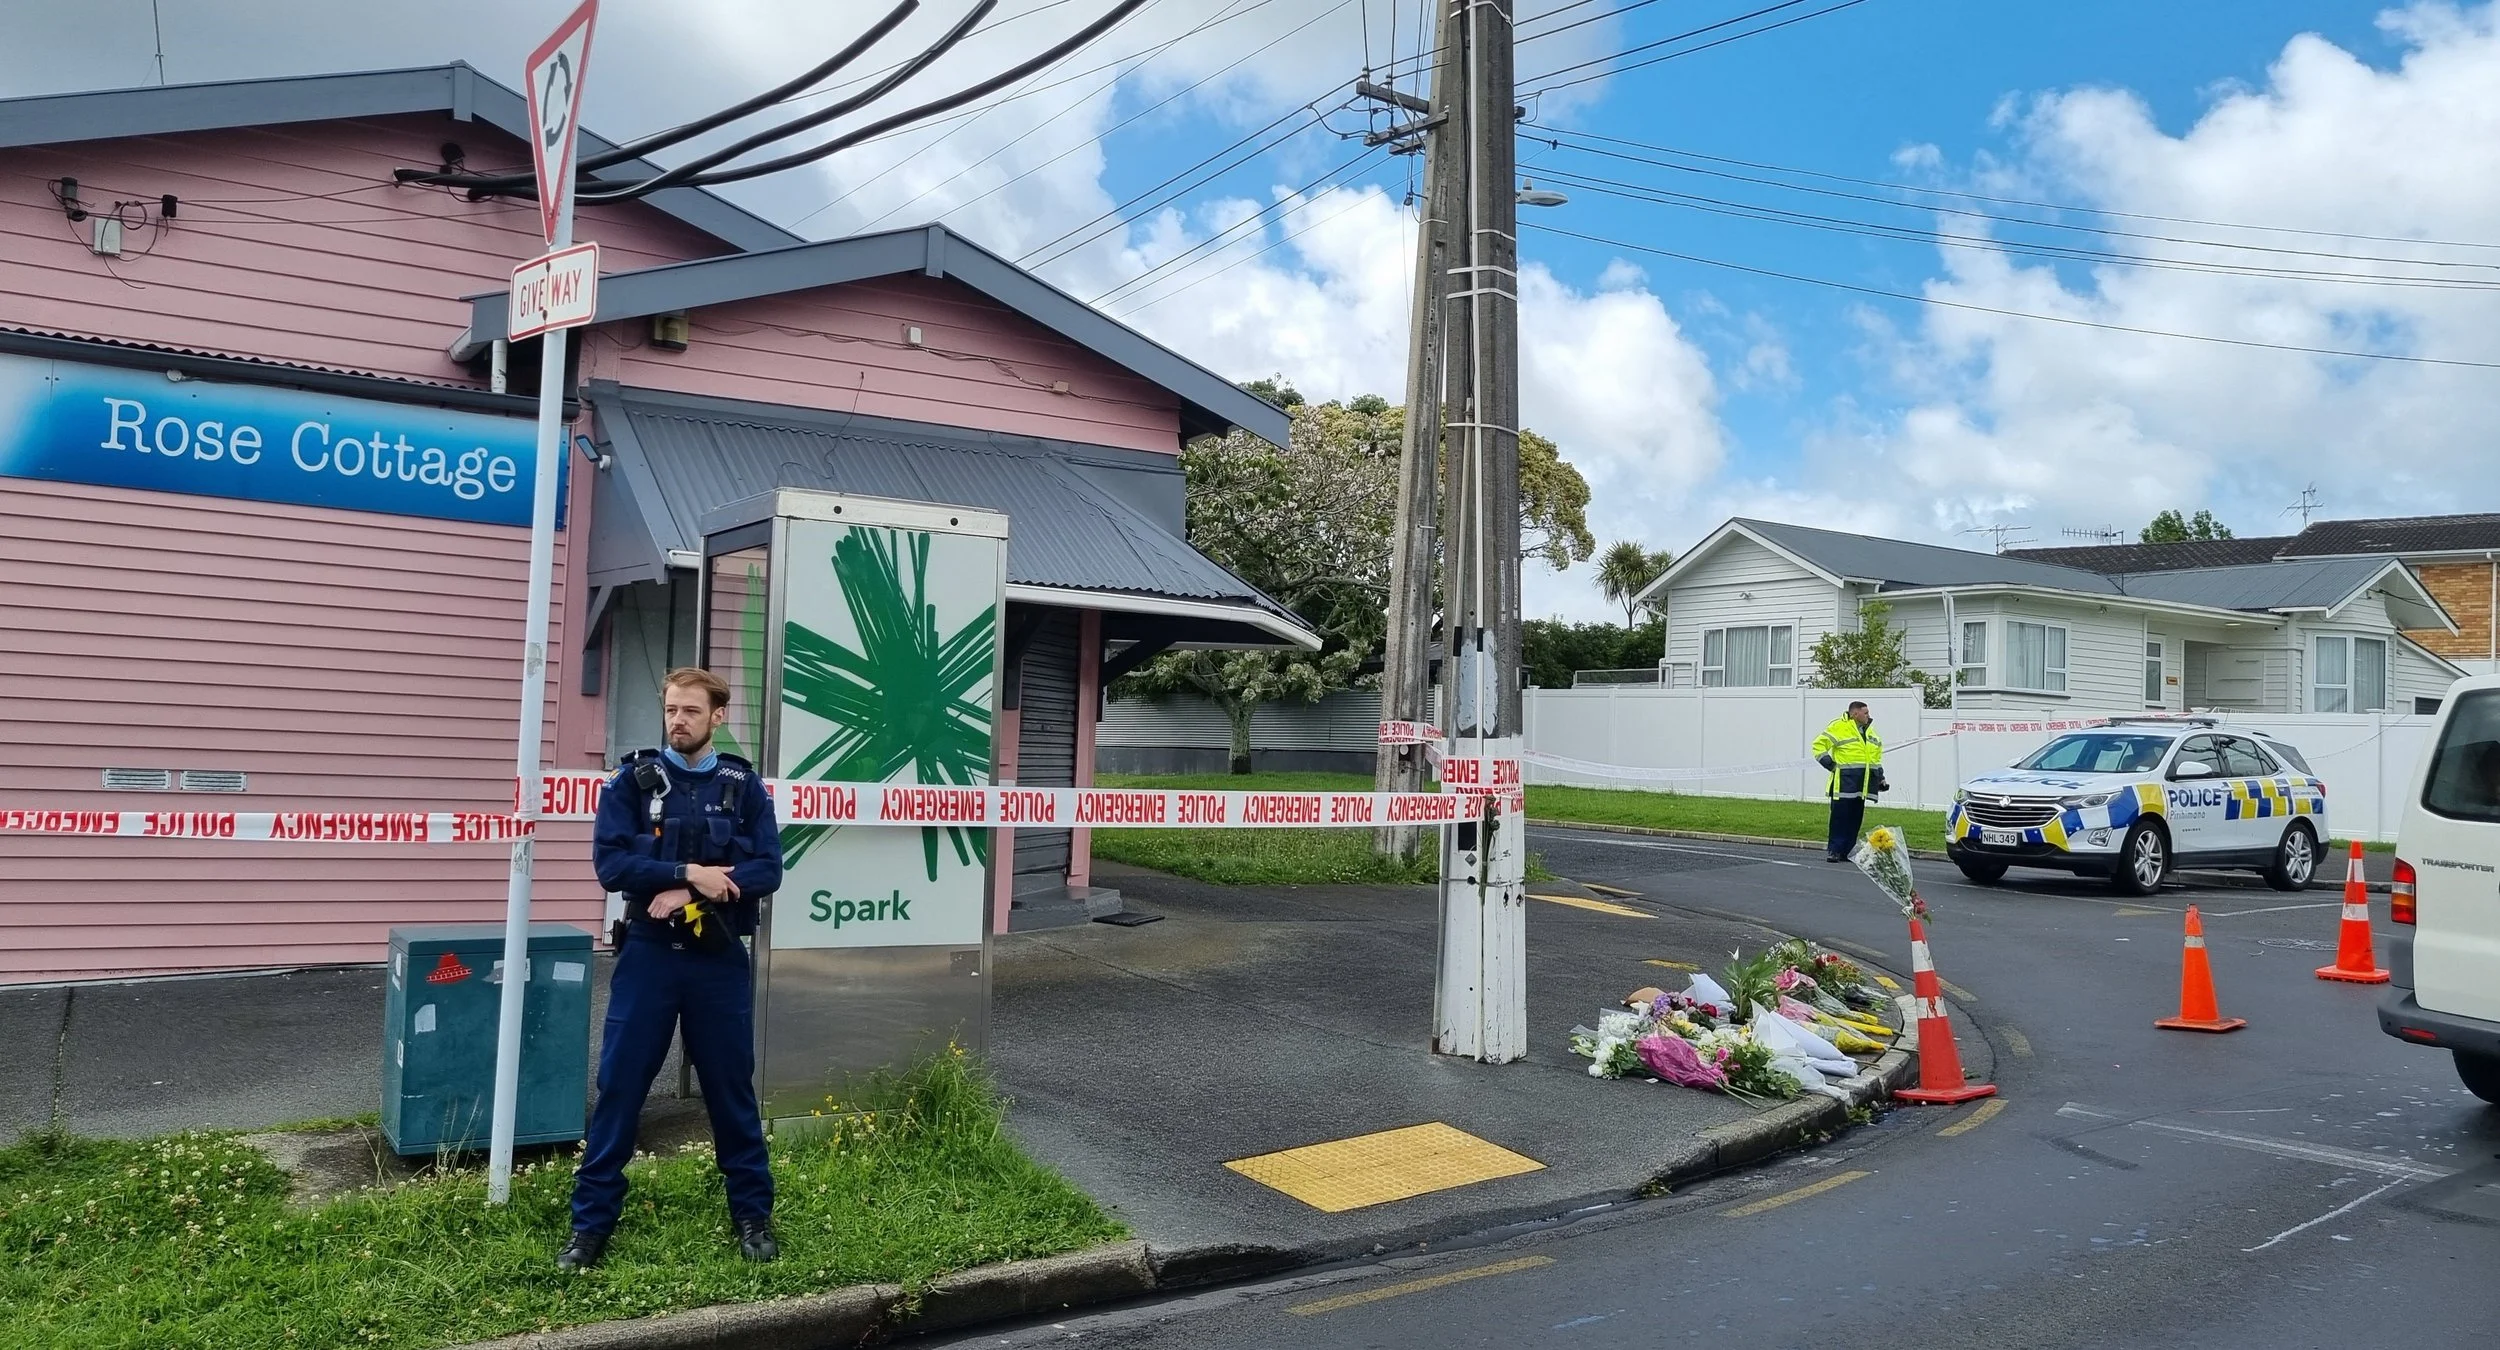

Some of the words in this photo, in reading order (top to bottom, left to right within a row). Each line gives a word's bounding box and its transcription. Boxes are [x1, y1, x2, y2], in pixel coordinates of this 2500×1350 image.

[520, 279, 547, 317] GIVE
[551, 269, 582, 307] WAY
[100, 396, 263, 466] Rose
[290, 421, 517, 500] Cottage
[1392, 722, 1414, 736] POLICE
[1493, 760, 1520, 785] POLICE
[542, 776, 605, 814] OLICE
[792, 785, 856, 820] POLICE
[880, 788, 985, 821] EMERGENCY
[1000, 791, 1055, 822] POLICE
[1075, 792, 1166, 823] EMERGENCY
[1178, 795, 1225, 823] POLICE
[1242, 796, 1321, 823] EMERGENCY
[1331, 796, 1373, 822] POLICE
[1387, 796, 1456, 822] EMERGENCY
[2168, 788, 2223, 808] POLICE
[269, 813, 429, 842] EMERGENCY
[2421, 858, 2495, 873] TRANSPORTER
[809, 890, 911, 929] Spark
